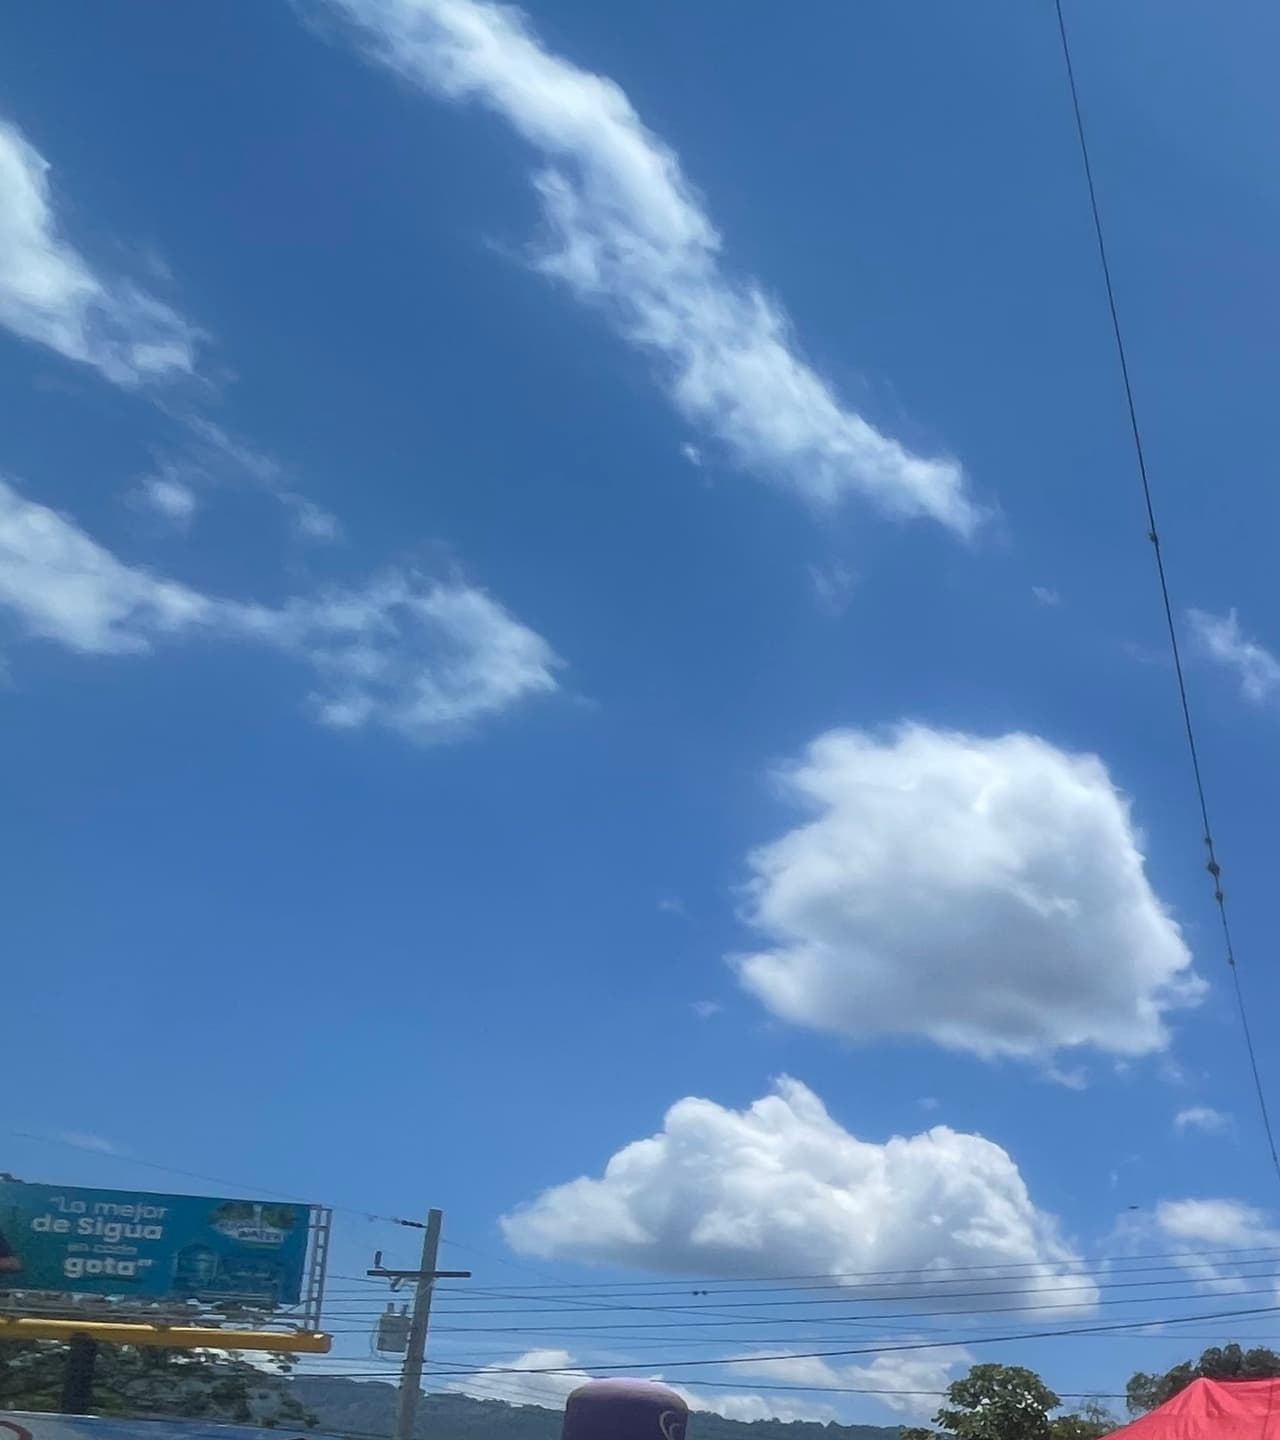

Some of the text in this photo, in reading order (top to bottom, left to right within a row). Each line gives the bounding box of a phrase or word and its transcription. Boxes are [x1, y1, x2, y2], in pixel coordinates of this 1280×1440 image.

[94, 1202, 168, 1222] mejor
[32, 1214, 163, 1242] de Sigua
